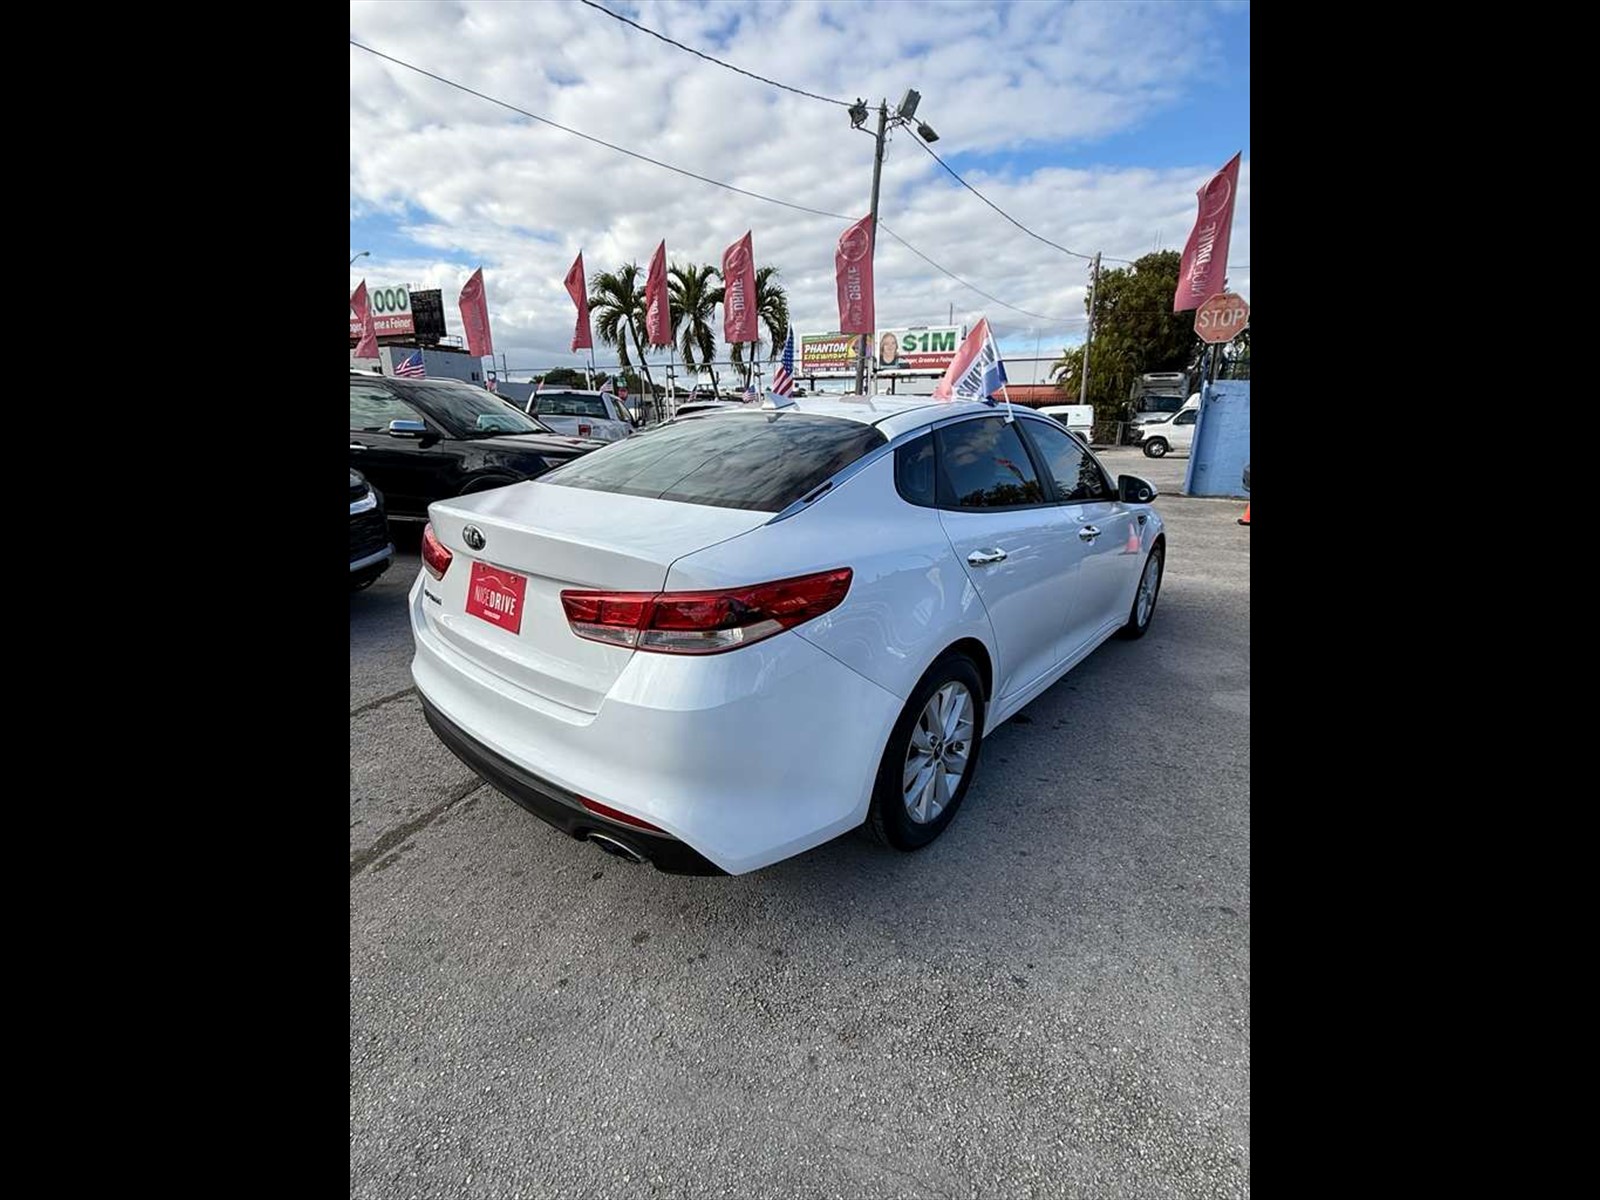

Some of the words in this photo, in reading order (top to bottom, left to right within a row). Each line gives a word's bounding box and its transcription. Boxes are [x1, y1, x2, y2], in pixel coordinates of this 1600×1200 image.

[367, 287, 408, 315] ,000
[1199, 309, 1245, 328] STOP
[804, 342, 848, 354] PHANTOM
[902, 331, 956, 352] $1M
